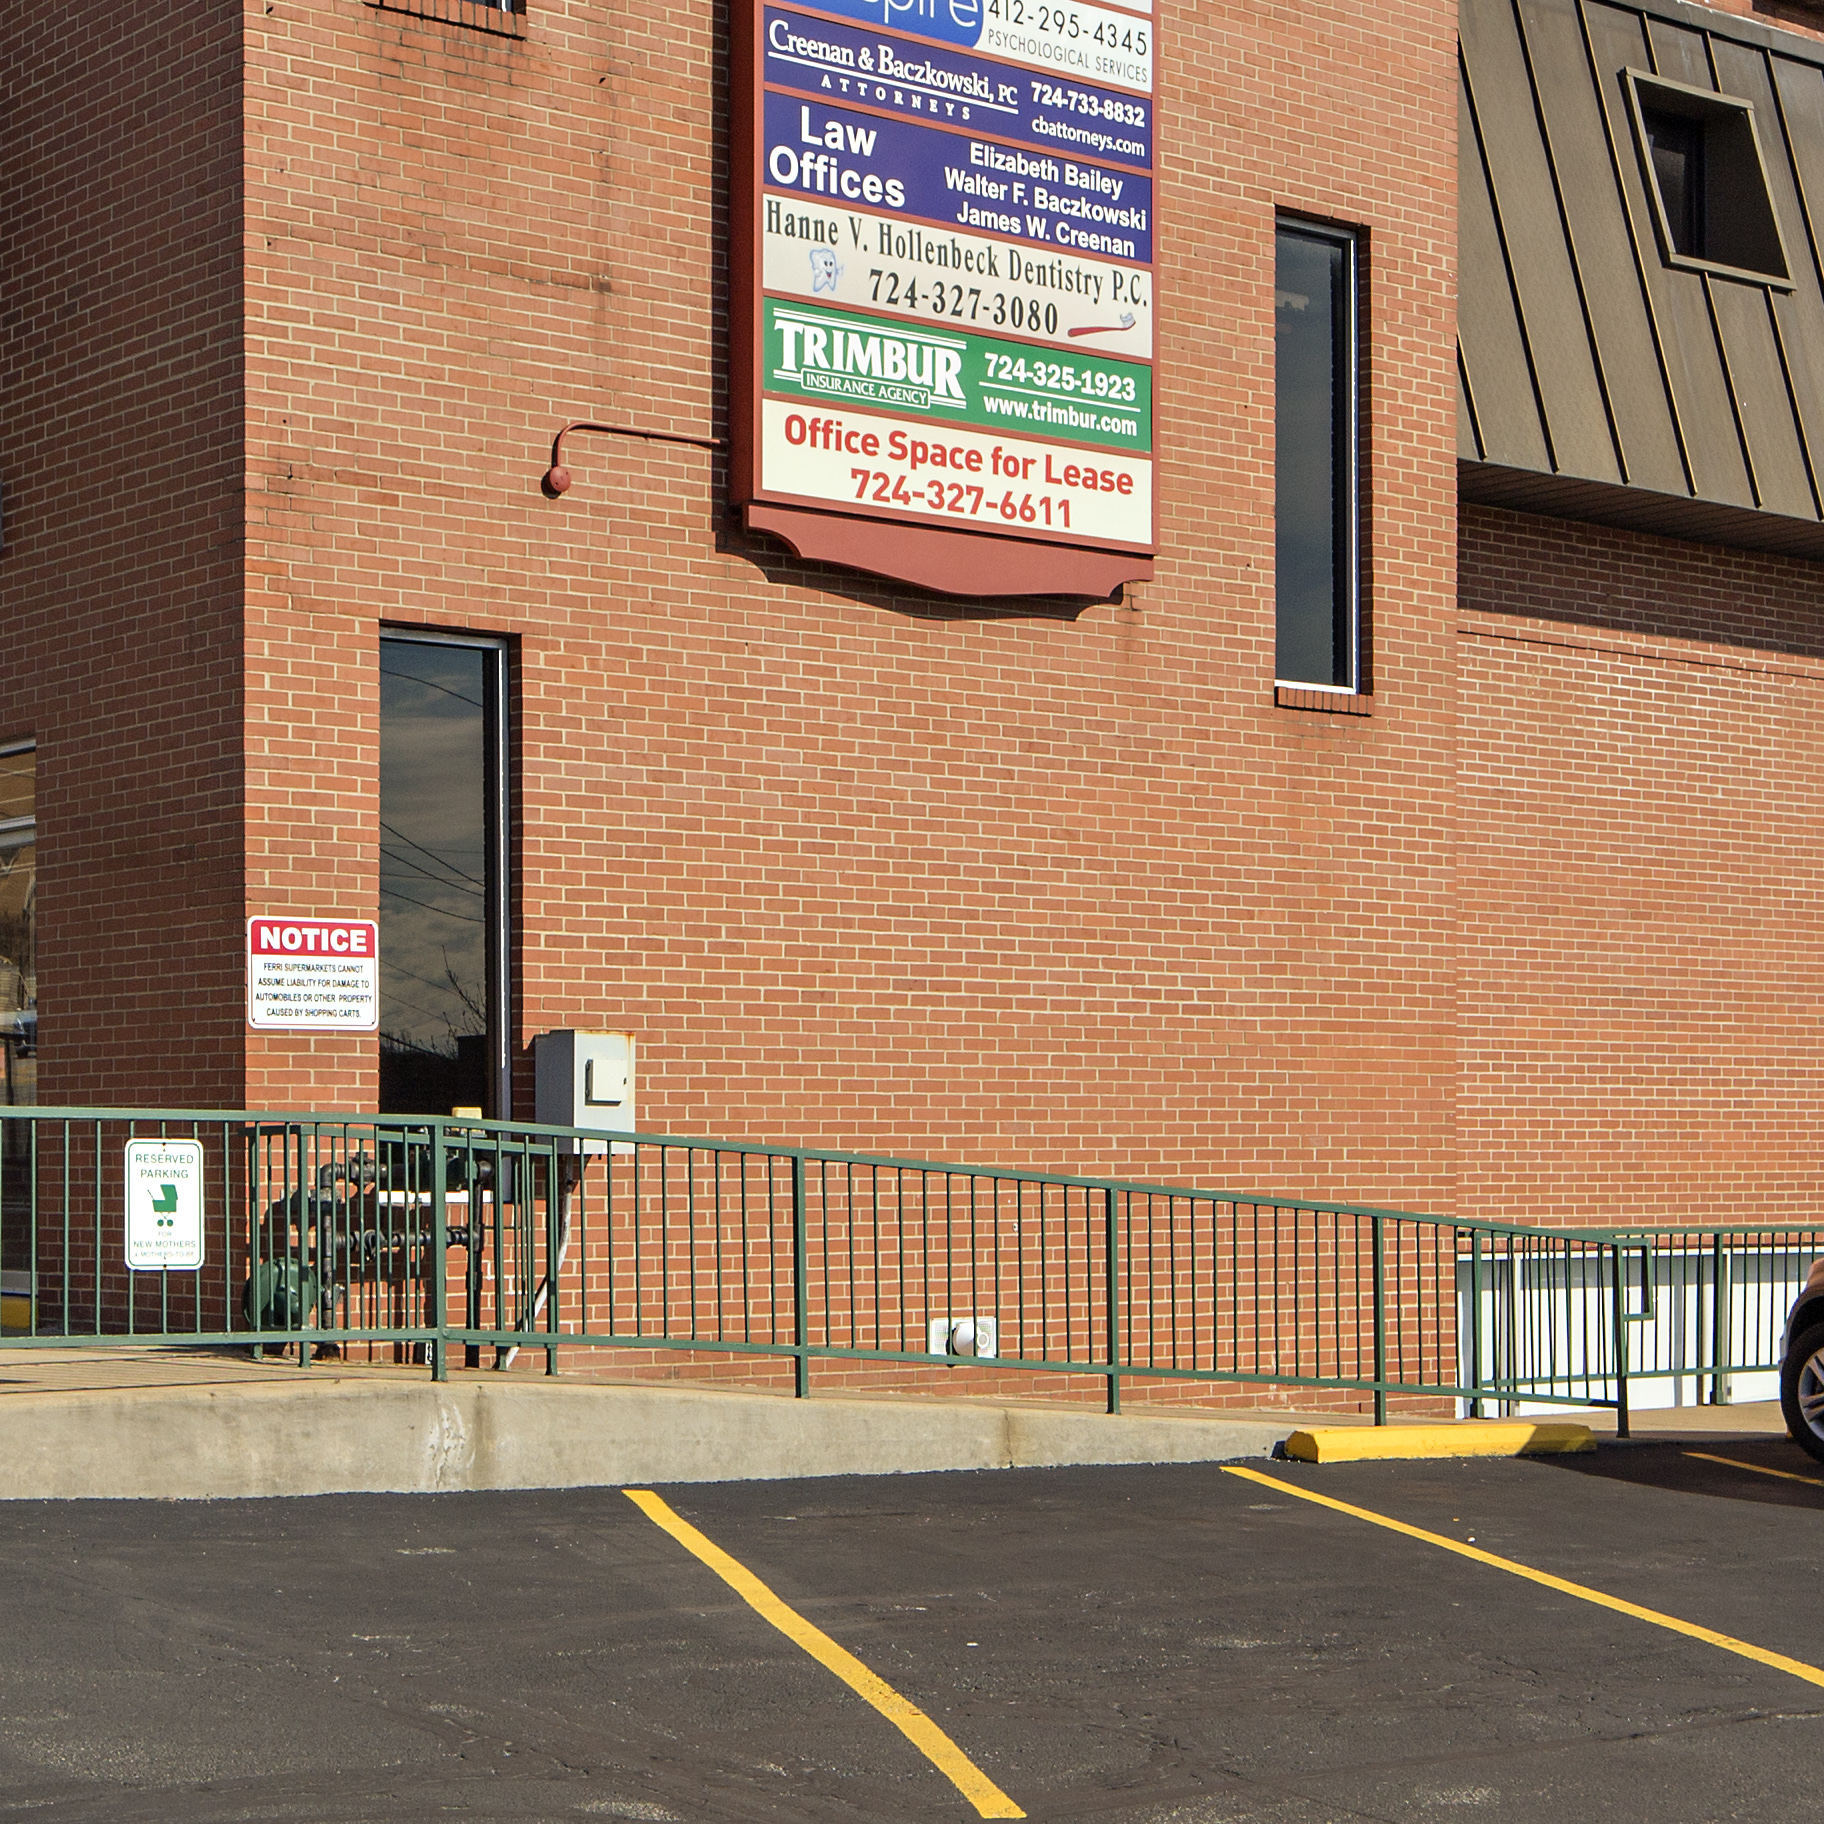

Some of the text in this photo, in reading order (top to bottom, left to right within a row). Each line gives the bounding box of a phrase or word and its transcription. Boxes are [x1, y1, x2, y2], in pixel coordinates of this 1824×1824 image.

[769, 20, 1018, 105] Creenan & Baczkowski, PC
[988, 29, 1147, 83] PSYCHOLOGICAL SERVICES
[821, 76, 972, 120] ATTORNEYS
[1031, 82, 1144, 127] 724-733-8832
[801, 107, 877, 156] Law
[1032, 116, 1144, 156] cbattorneys.com
[769, 147, 905, 208] Offices
[970, 142, 1123, 200] Elizabeth Bailey
[944, 167, 1146, 230] Walter F. Baczkowski
[766, 200, 1147, 306] Hanne V. Hollenbeck Dentistry P.C.
[956, 203, 1135, 257] James W. Creenan
[868, 269, 1058, 336] 724-327-3080
[774, 319, 965, 399] TRIMBUR
[985, 353, 1136, 402] 724-325-1923
[806, 373, 927, 405] INSURANCE AGENCY
[984, 396, 1137, 436] www.trimbur.com
[784, 415, 1133, 496] Office Space for Lease
[850, 468, 1070, 529] 724-327-6611
[260, 927, 367, 952] NOTICE
[258, 978, 284, 986] ASSUME
[287, 979, 316, 987] LIABILITY
[333, 980, 359, 988] DAMAGE
[264, 963, 363, 973] FERRI SUPERMARKETS CANNOT
[255, 993, 301, 1001] AUTOMOBILES
[339, 995, 372, 1003] PROPERTY
[267, 1008, 292, 1016] CAUSED
[305, 1009, 337, 1017] SHOPPING
[136, 1154, 194, 1163] RESERVED
[140, 1169, 188, 1178] PARKING
